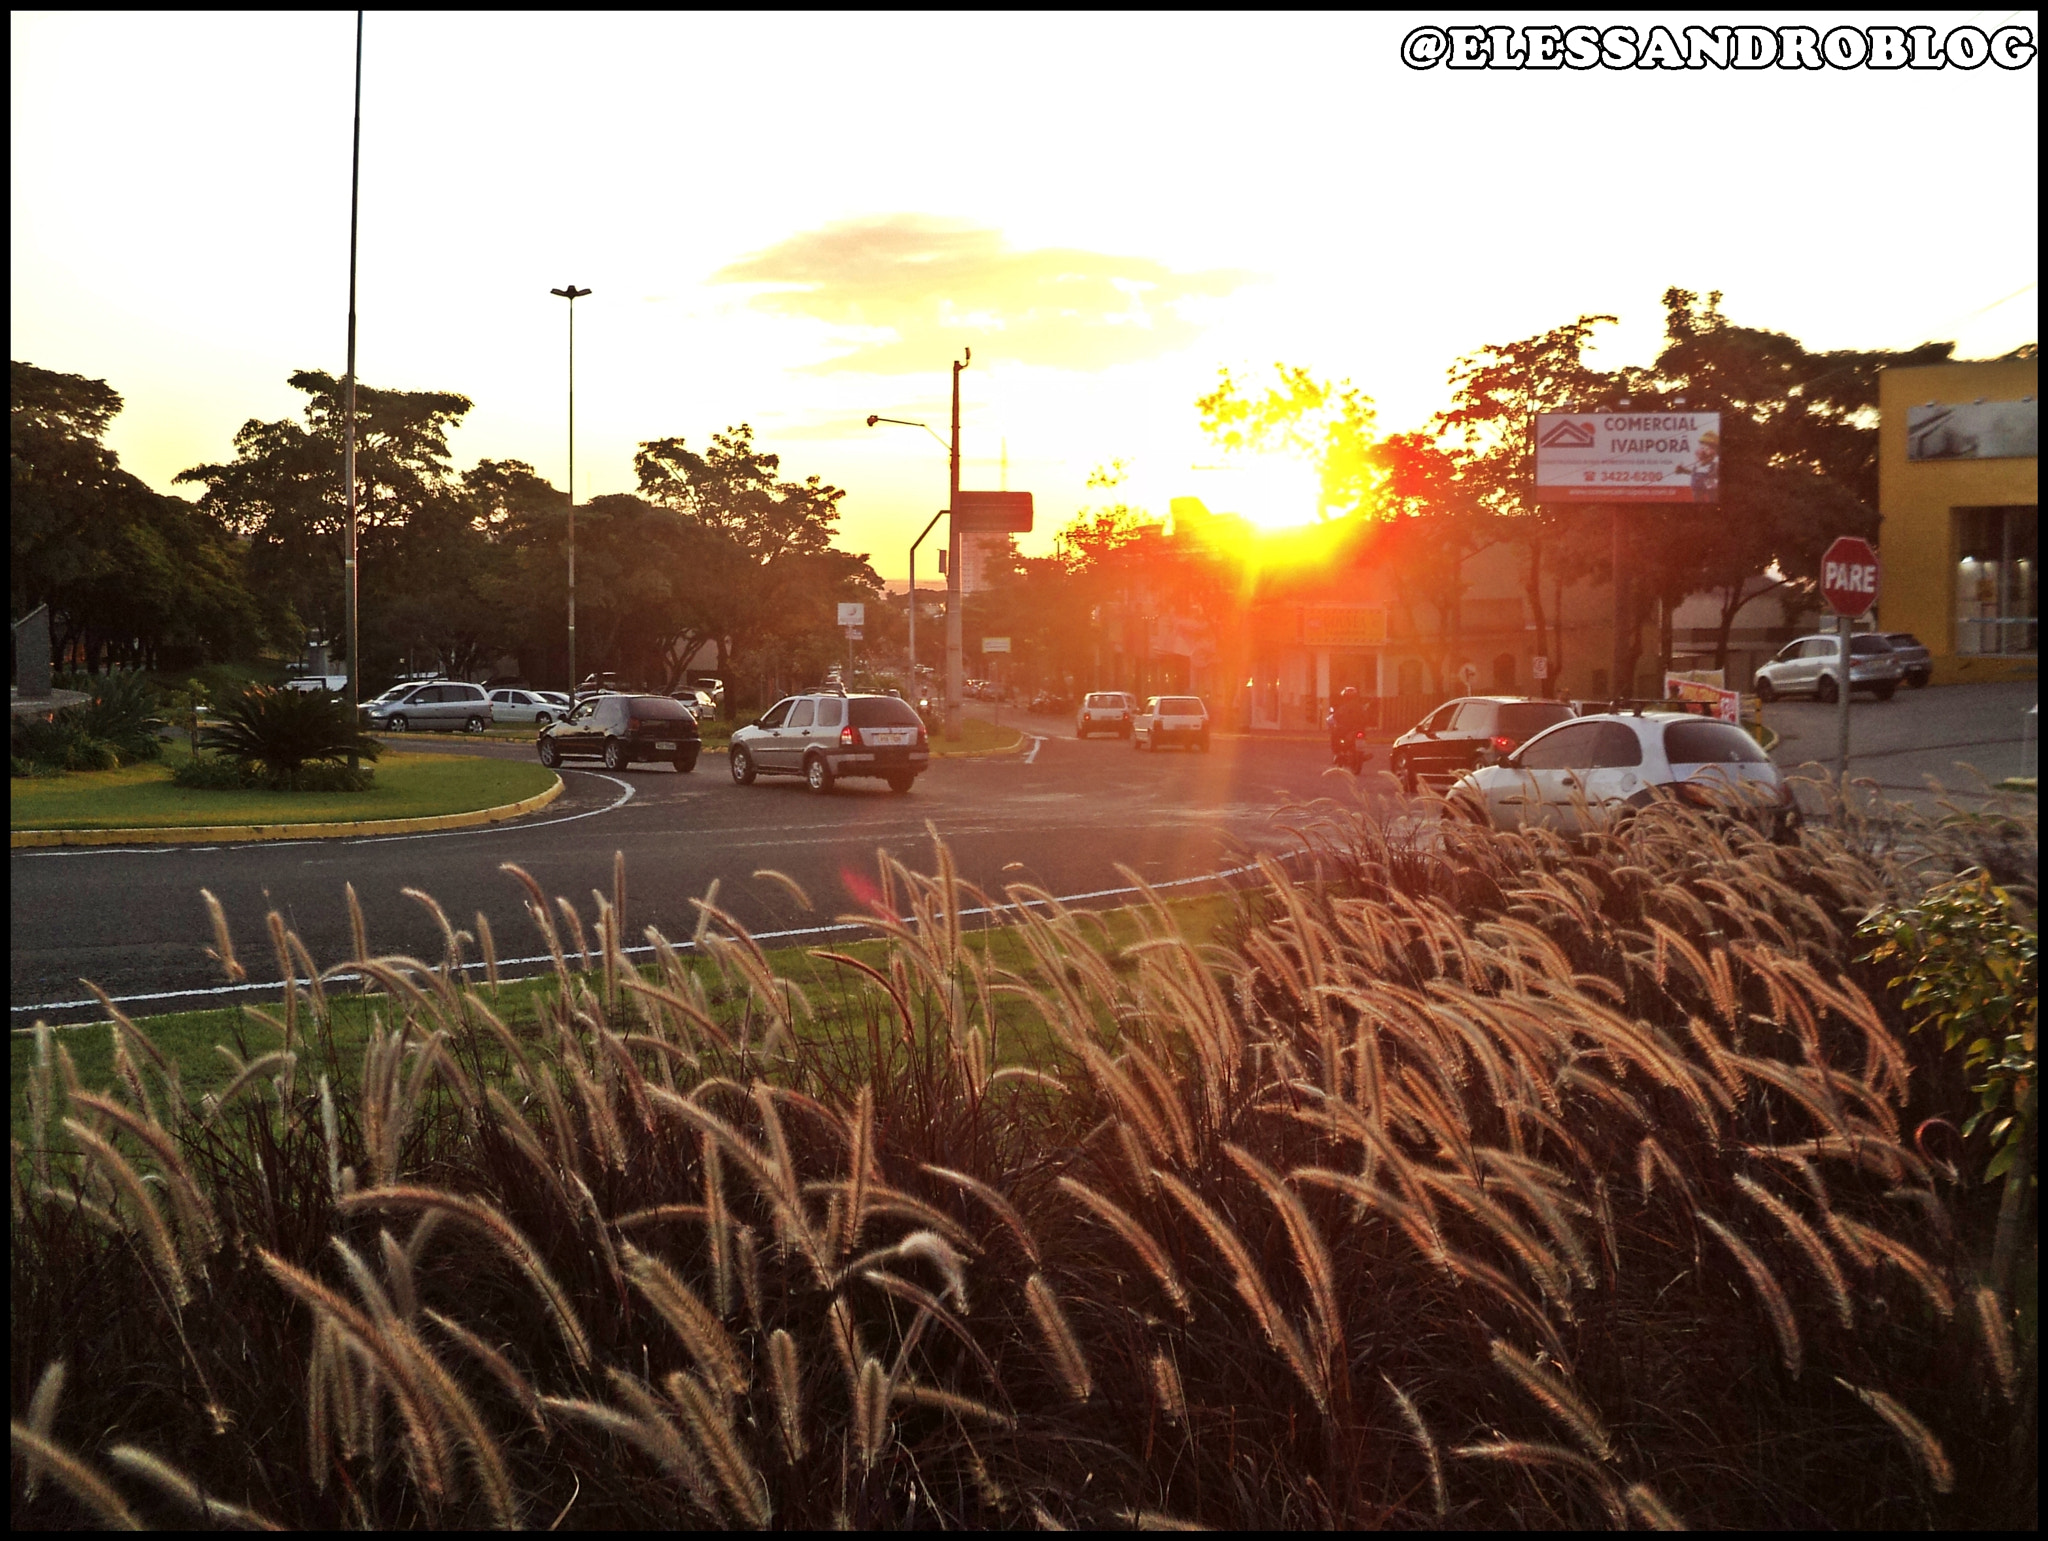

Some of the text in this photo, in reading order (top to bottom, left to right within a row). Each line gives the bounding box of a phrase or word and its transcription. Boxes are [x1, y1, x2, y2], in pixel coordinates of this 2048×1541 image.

[1604, 417, 1697, 431] COMERCIAL
[1611, 436, 1690, 453] IVAIPORÃ
[1825, 561, 1876, 593] PARE
